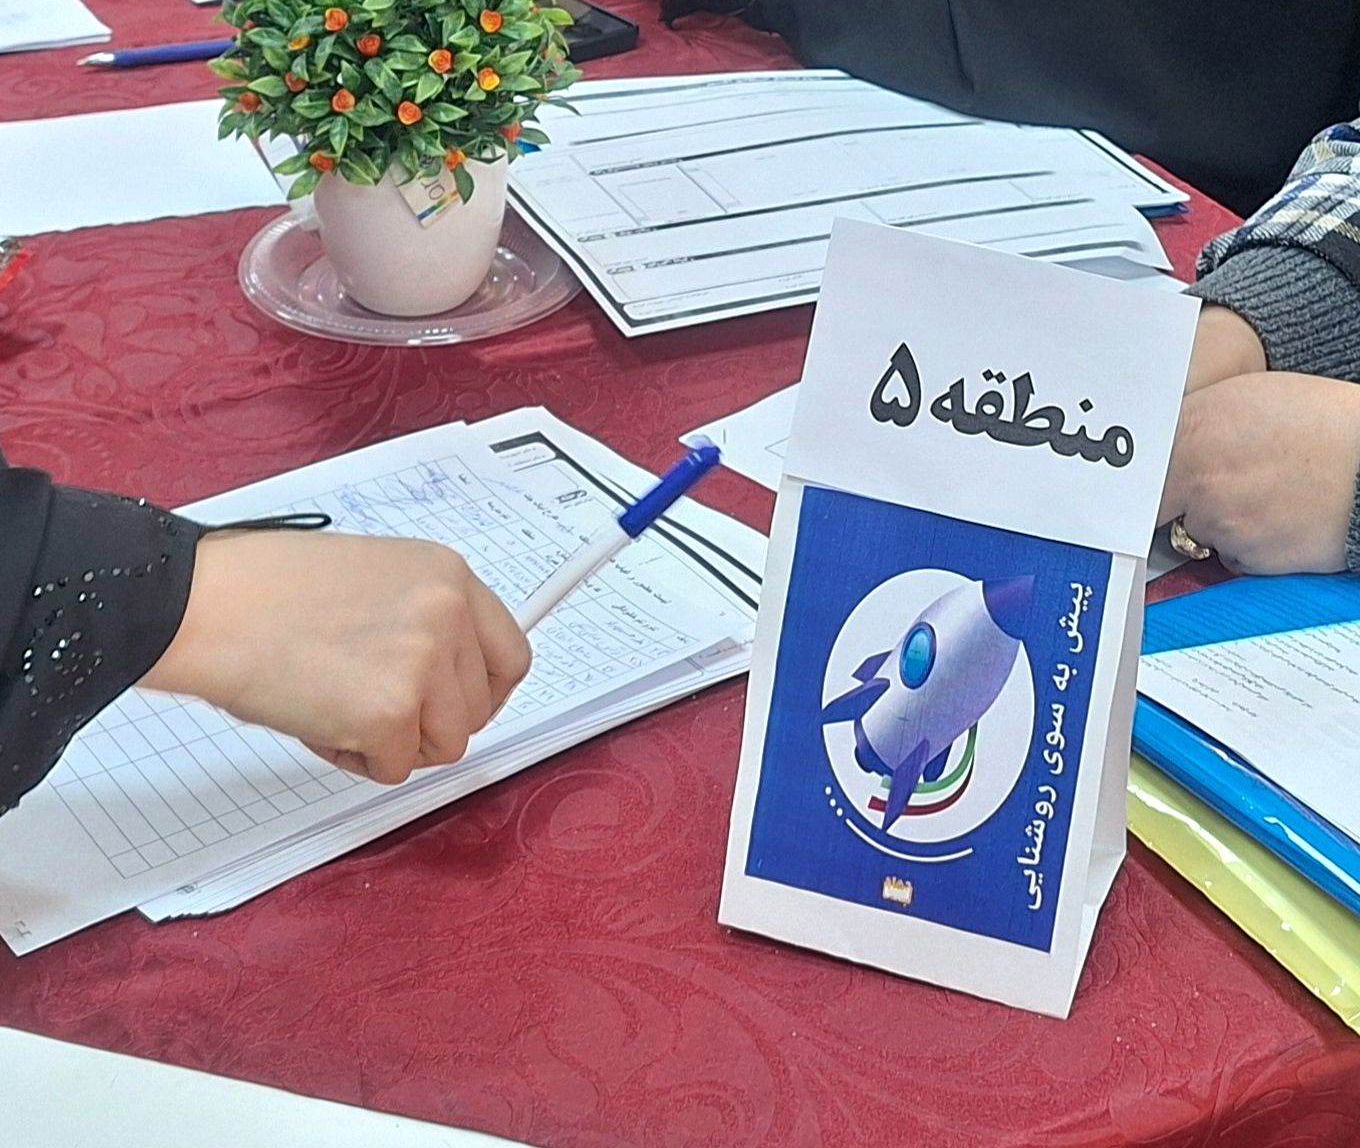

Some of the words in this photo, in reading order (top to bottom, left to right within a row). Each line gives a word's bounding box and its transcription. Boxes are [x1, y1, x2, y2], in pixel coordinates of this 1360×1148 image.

[870, 342, 922, 427] ۵
[930, 369, 1134, 468] منطقه
[1059, 582, 1093, 653] پیش
[1052, 663, 1078, 691] به
[1043, 703, 1065, 774] سوی
[1017, 785, 1057, 910] روشنایی
